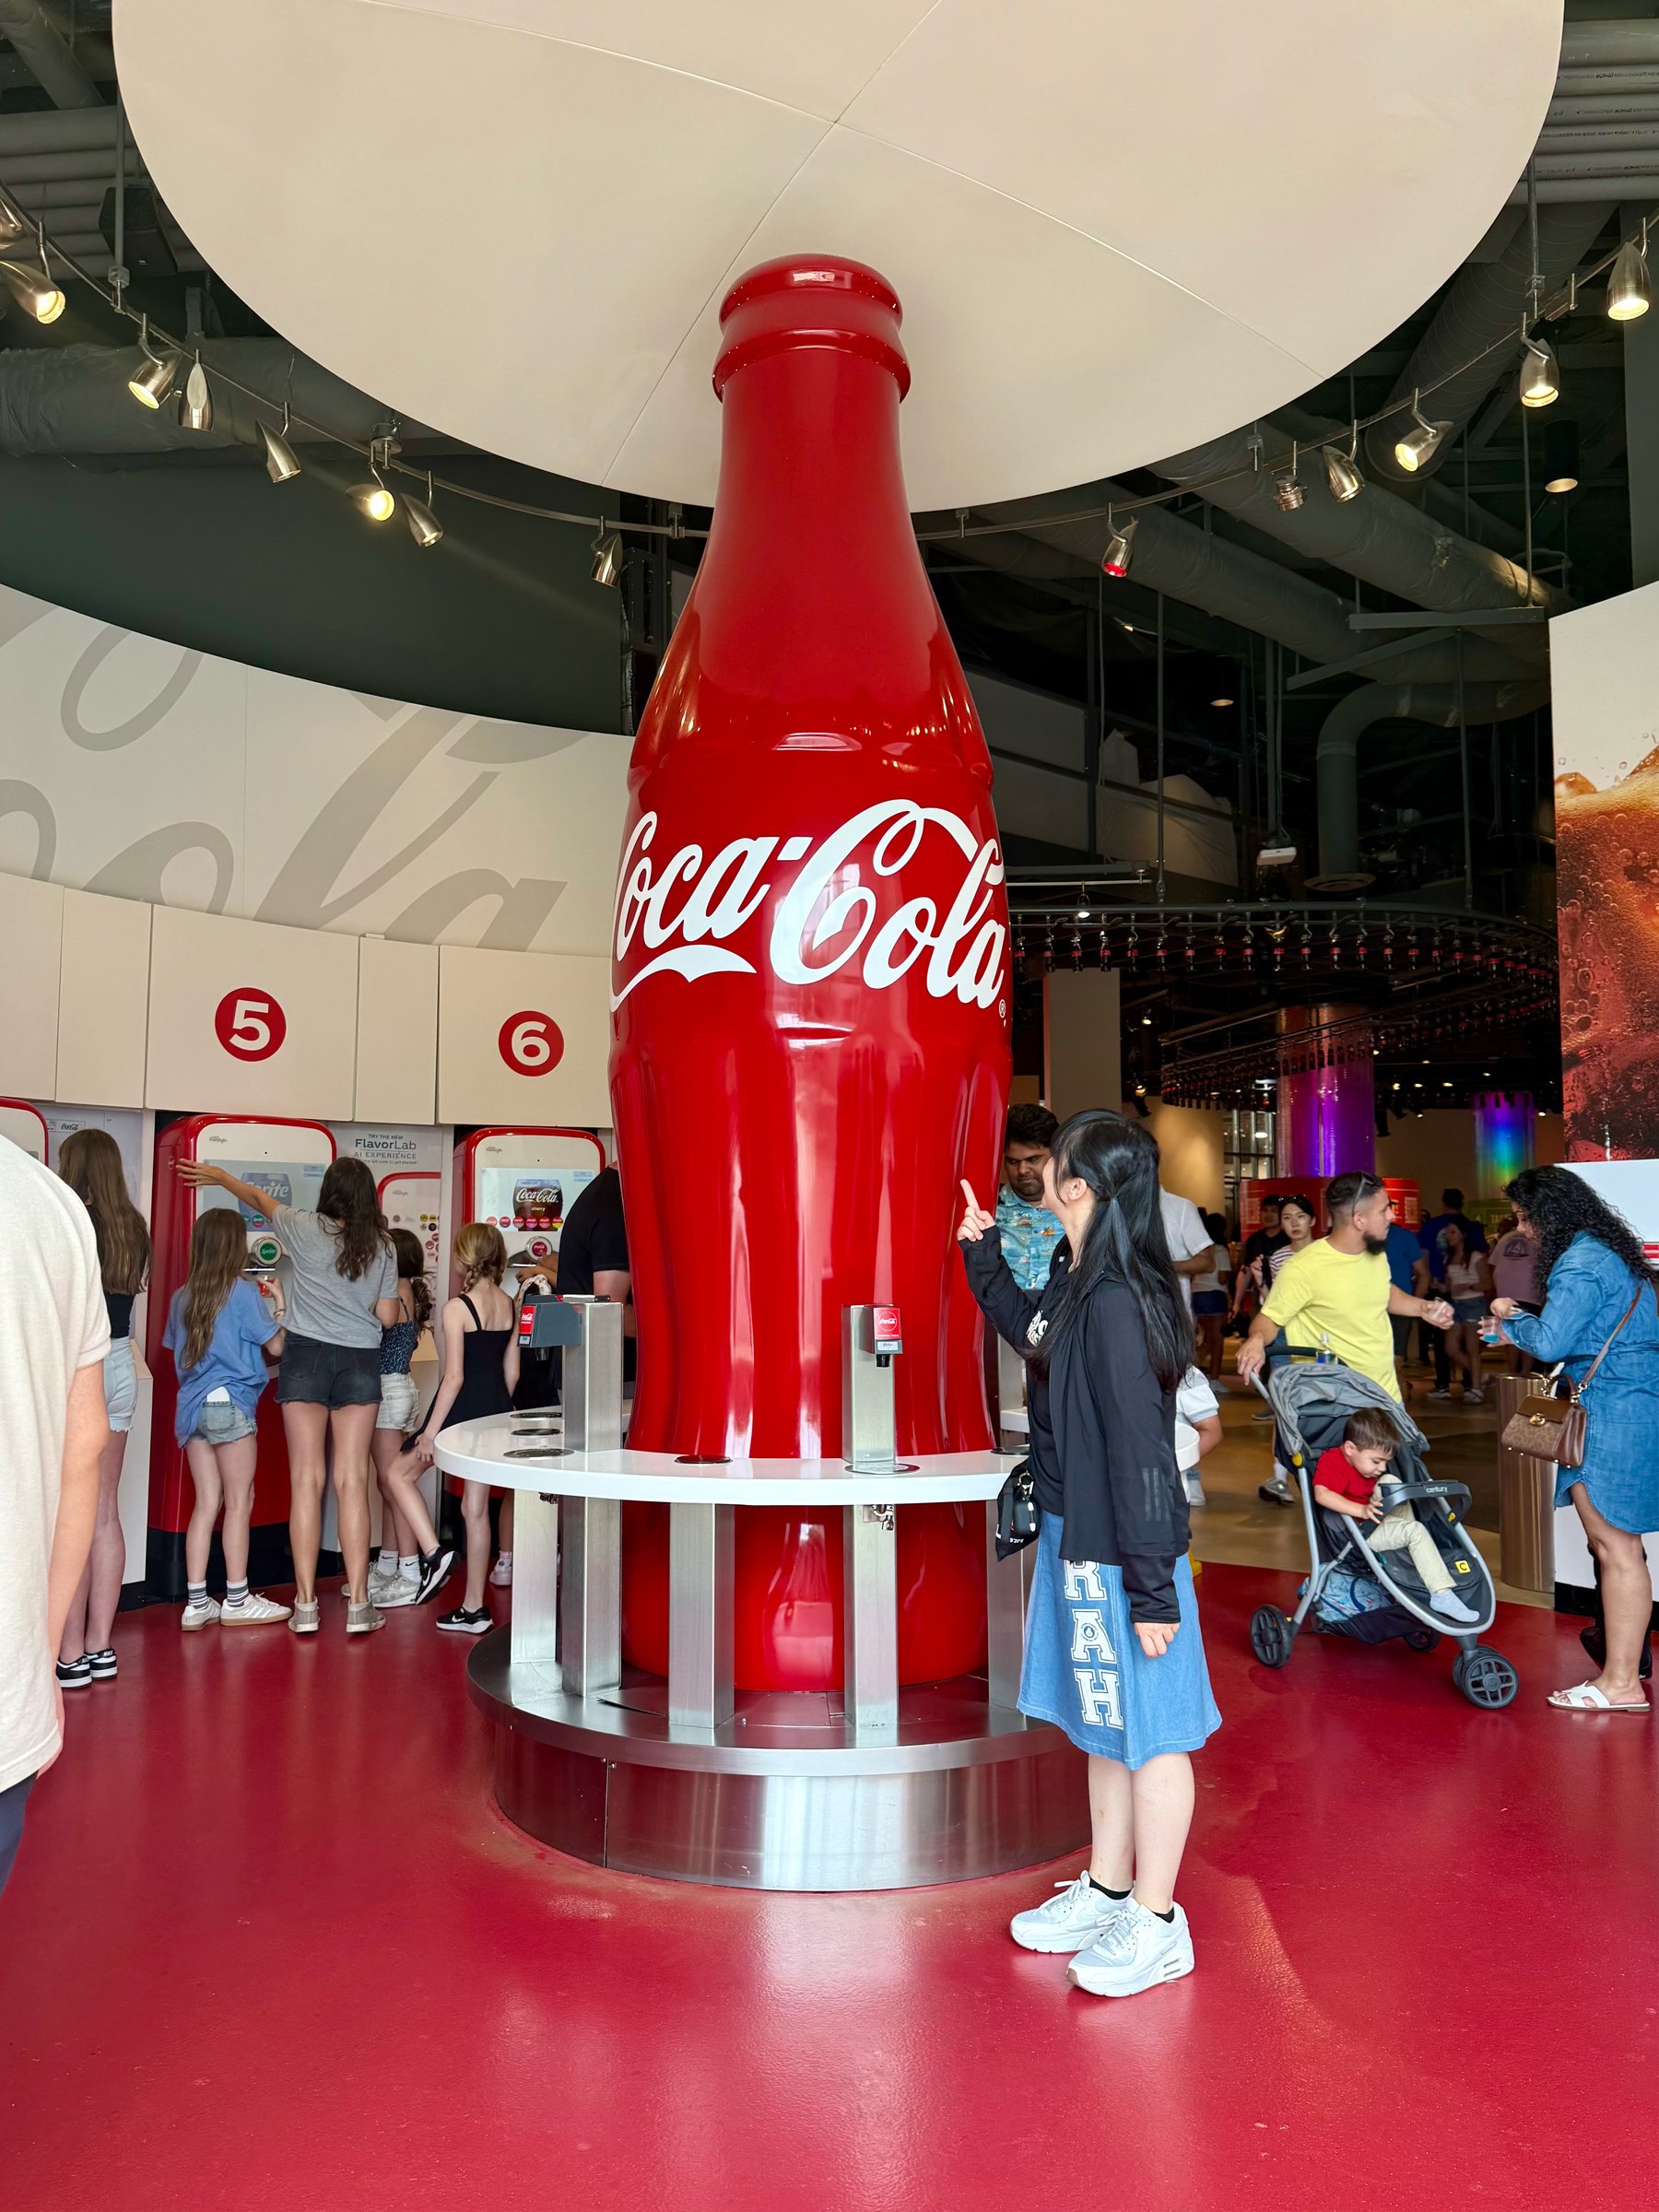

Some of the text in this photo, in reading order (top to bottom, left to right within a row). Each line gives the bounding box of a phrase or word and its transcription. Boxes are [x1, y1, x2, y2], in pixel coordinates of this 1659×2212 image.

[610, 799, 1006, 1012] Coca-Cola
[229, 1000, 271, 1051] 5
[512, 1021, 549, 1066] 6
[355, 1138, 417, 1150] FlavorLab
[365, 1151, 418, 1159] EXPERIENCE
[246, 1181, 288, 1198] rite
[516, 1187, 559, 1203] Coca-Cola
[1426, 1486, 1448, 1494] century
[1460, 1562, 1467, 1571] C
